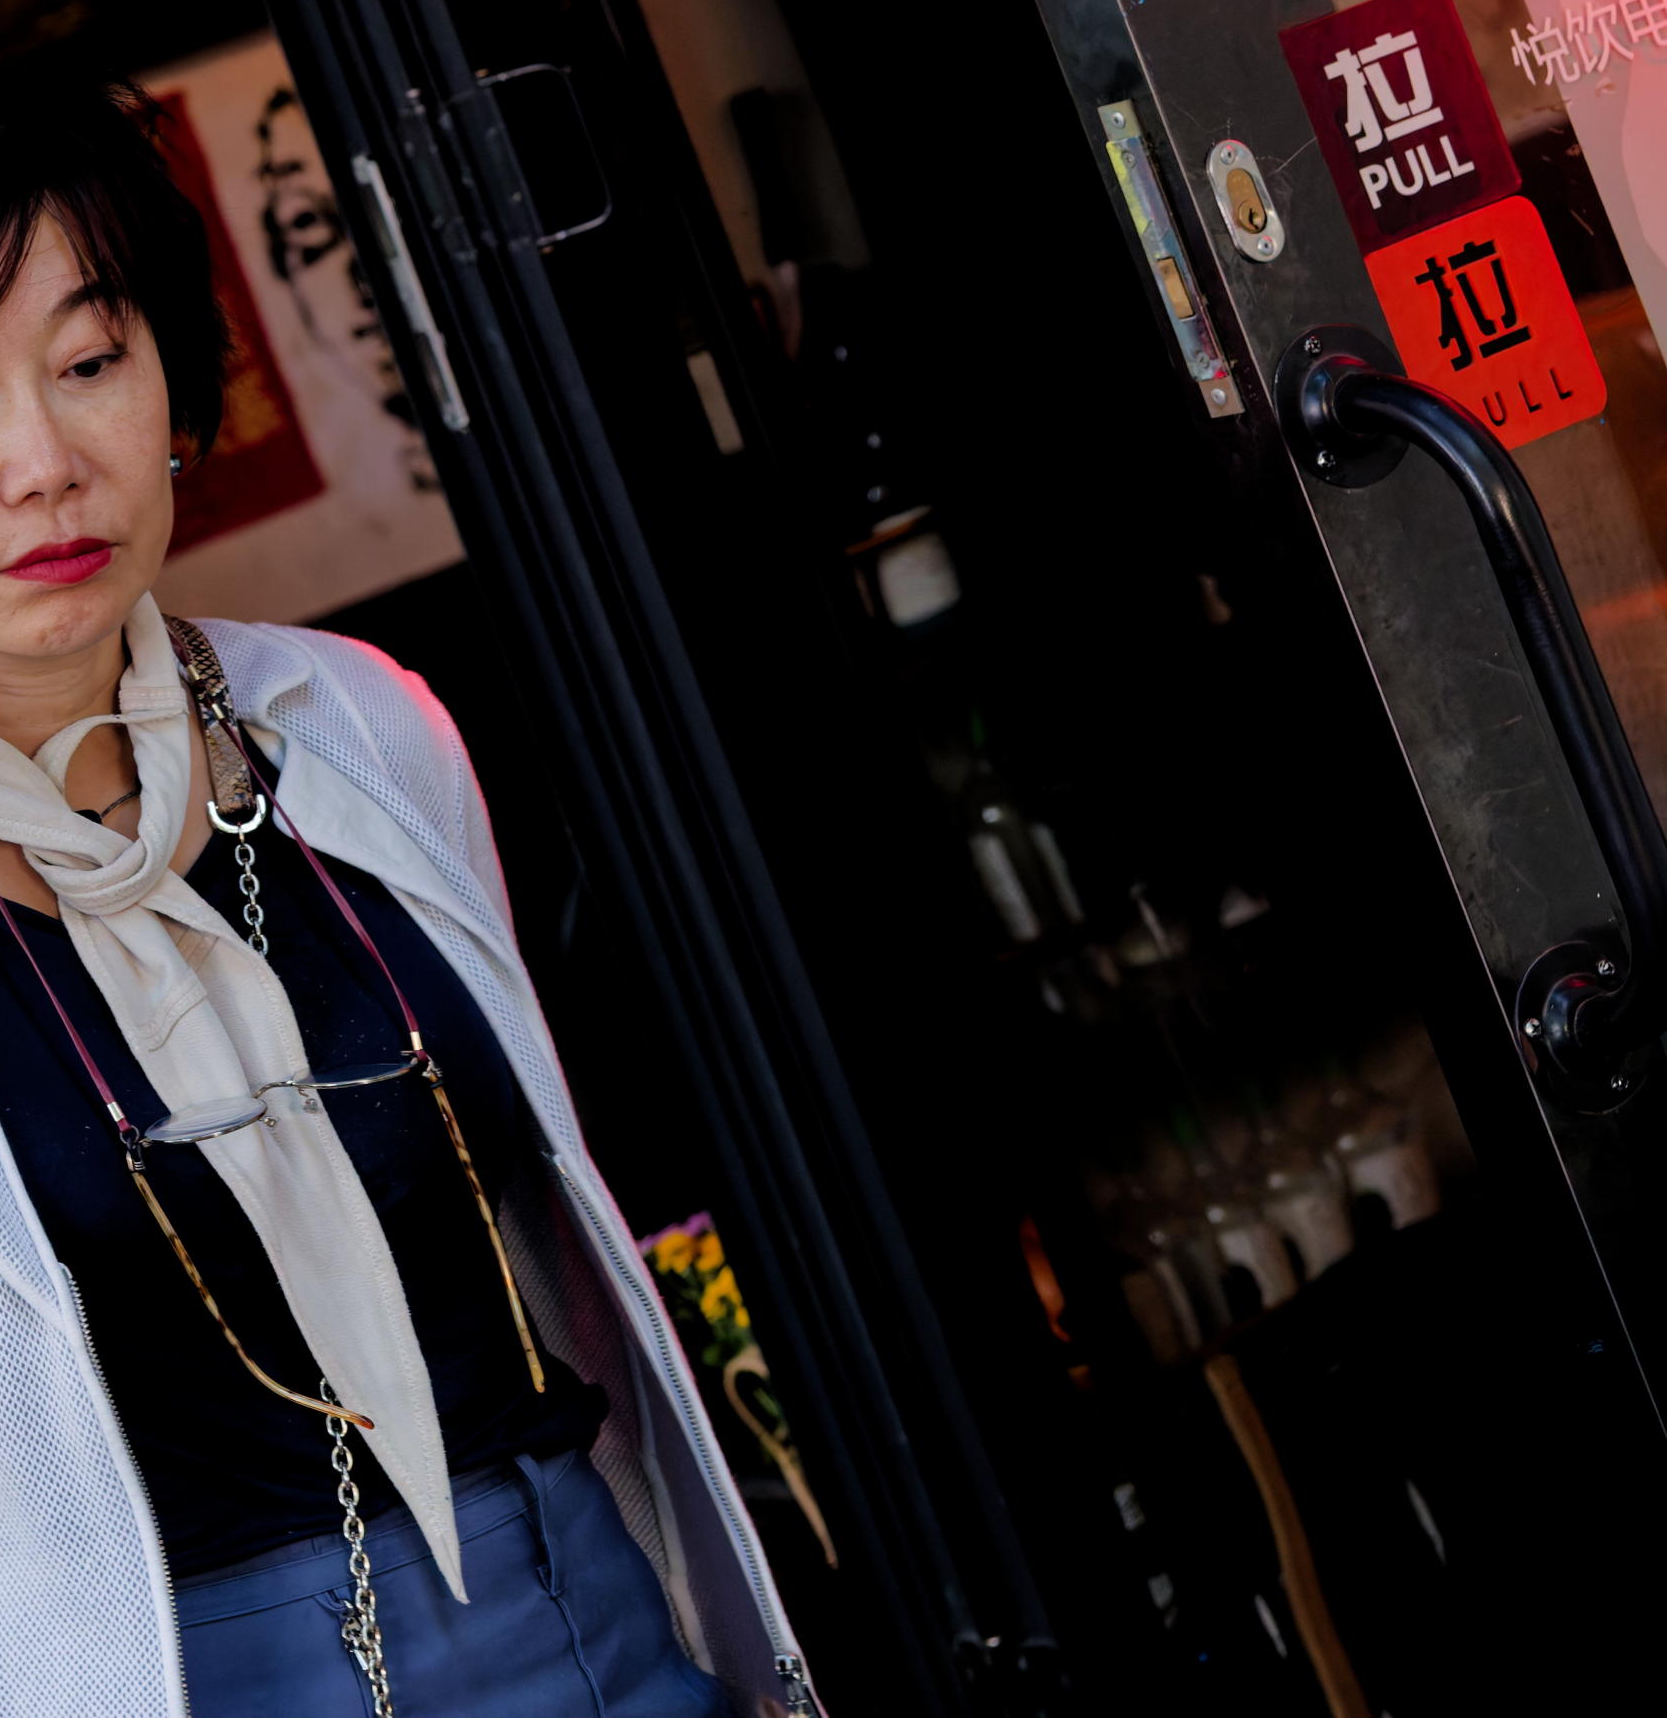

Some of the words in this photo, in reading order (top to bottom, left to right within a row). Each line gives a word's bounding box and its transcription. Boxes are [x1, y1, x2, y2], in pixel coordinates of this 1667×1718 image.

[1323, 29, 1445, 154] 拉
[1358, 134, 1476, 210] PULL
[1414, 239, 1533, 373] 拉
[1481, 366, 1574, 428] ULL
